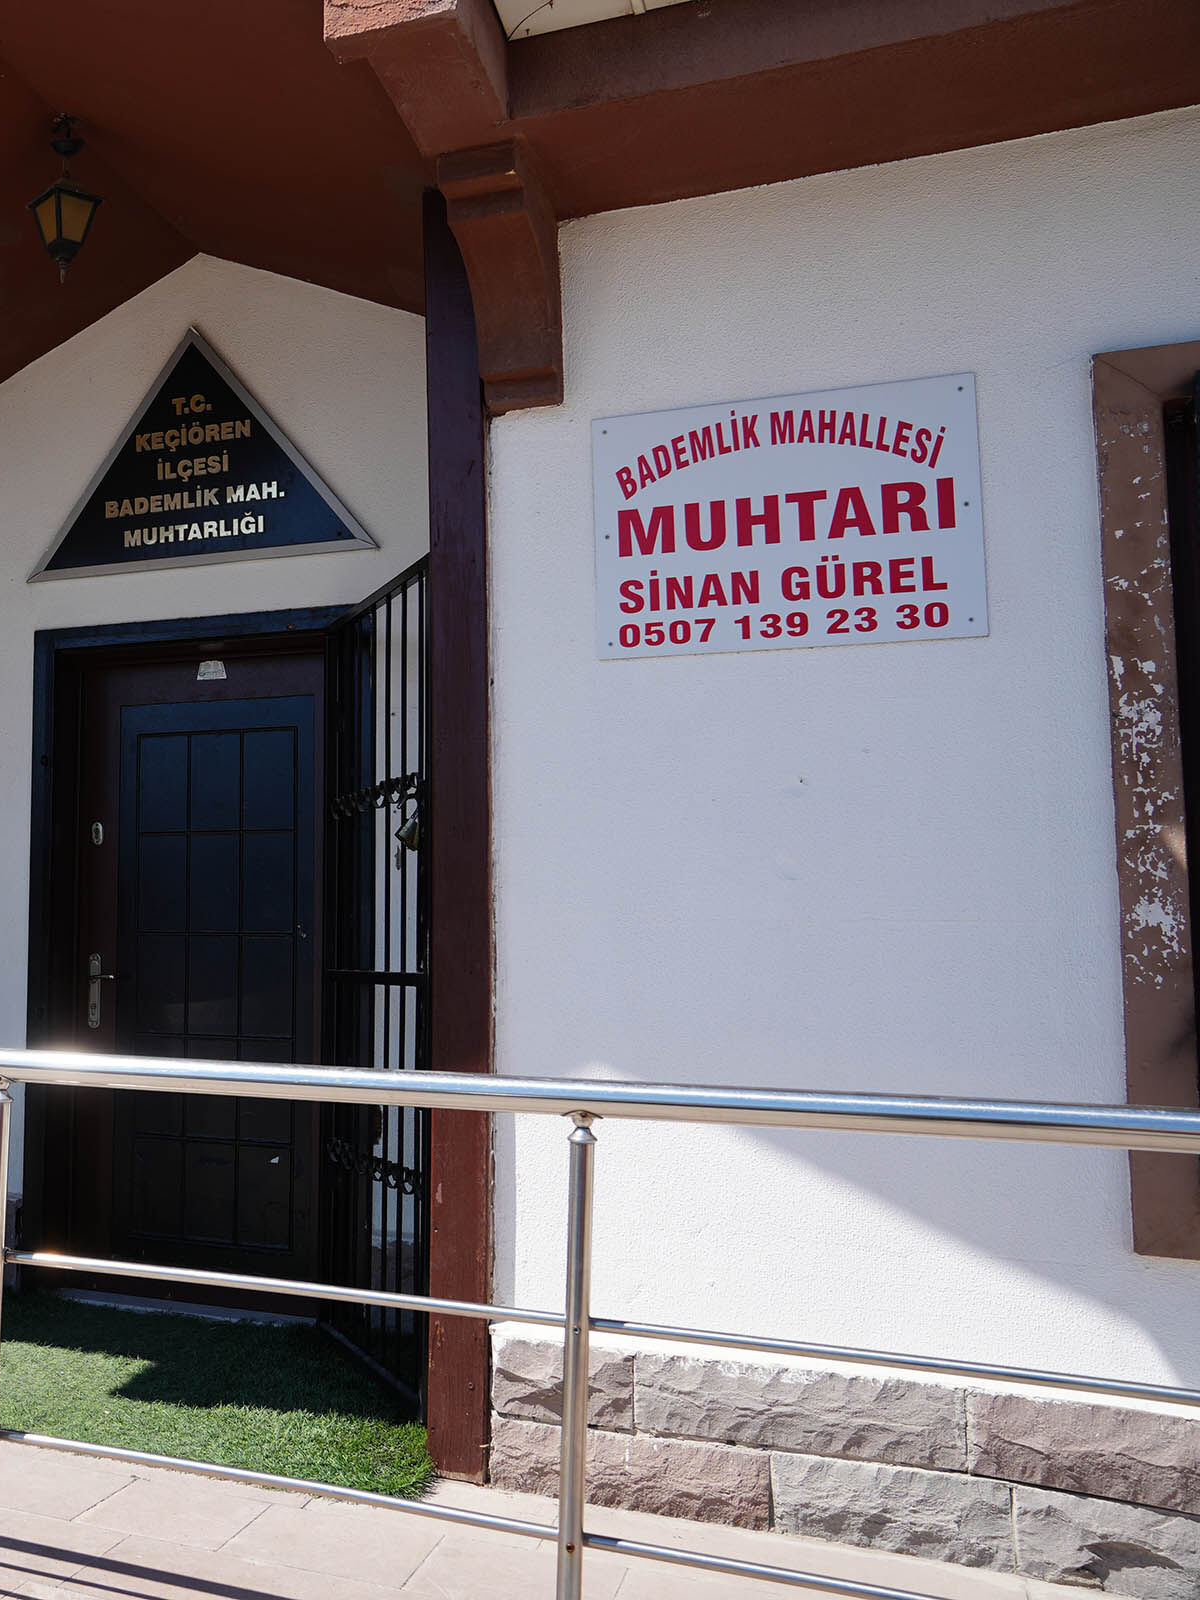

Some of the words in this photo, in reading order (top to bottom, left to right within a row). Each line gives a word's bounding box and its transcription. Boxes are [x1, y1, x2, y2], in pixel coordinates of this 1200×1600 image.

[172, 395, 213, 416] T.C.
[135, 419, 251, 452] KEÇİÖREN
[157, 450, 230, 481] İLÇESİ
[616, 410, 760, 500] BADEMLİK
[770, 410, 947, 469] MAHALLESİ
[105, 486, 219, 519] BADEMLİK
[226, 481, 285, 503] MAH.
[617, 477, 957, 558] MUHTARI
[124, 512, 265, 547] MUHTARLIĞI
[619, 570, 760, 614] SİNAN
[781, 555, 948, 602] GÜREL
[619, 618, 717, 648] 0507
[734, 612, 809, 639] 139
[826, 607, 878, 635] 23
[896, 602, 949, 630] 30
